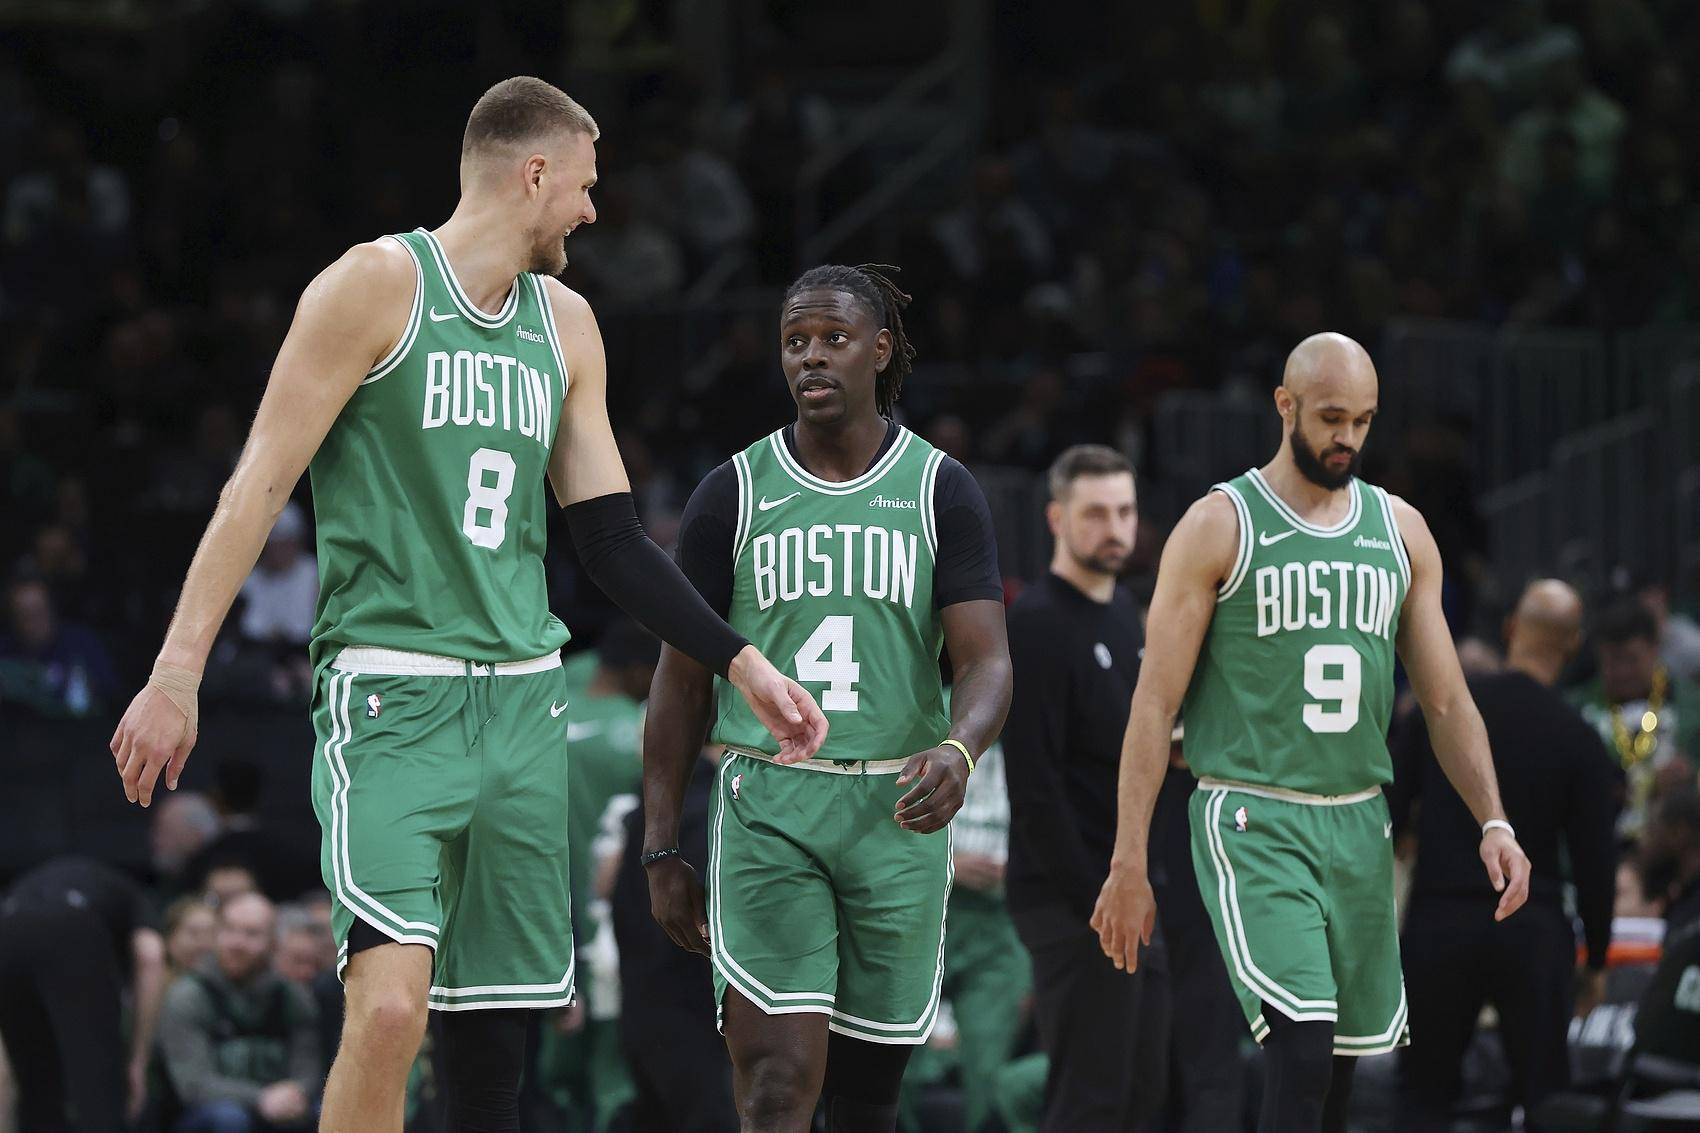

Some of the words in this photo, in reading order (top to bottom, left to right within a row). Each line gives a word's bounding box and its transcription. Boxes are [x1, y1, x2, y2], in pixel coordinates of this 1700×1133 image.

[516, 324, 545, 344] Amica
[422, 350, 552, 449] BOSTON
[463, 447, 516, 550] 8
[868, 494, 917, 509] Amica
[1353, 533, 1392, 551] Amica
[753, 524, 918, 611] BOSTON
[1255, 560, 1398, 640] BOSTON
[794, 615, 860, 711] 4
[1302, 644, 1361, 733] 9
